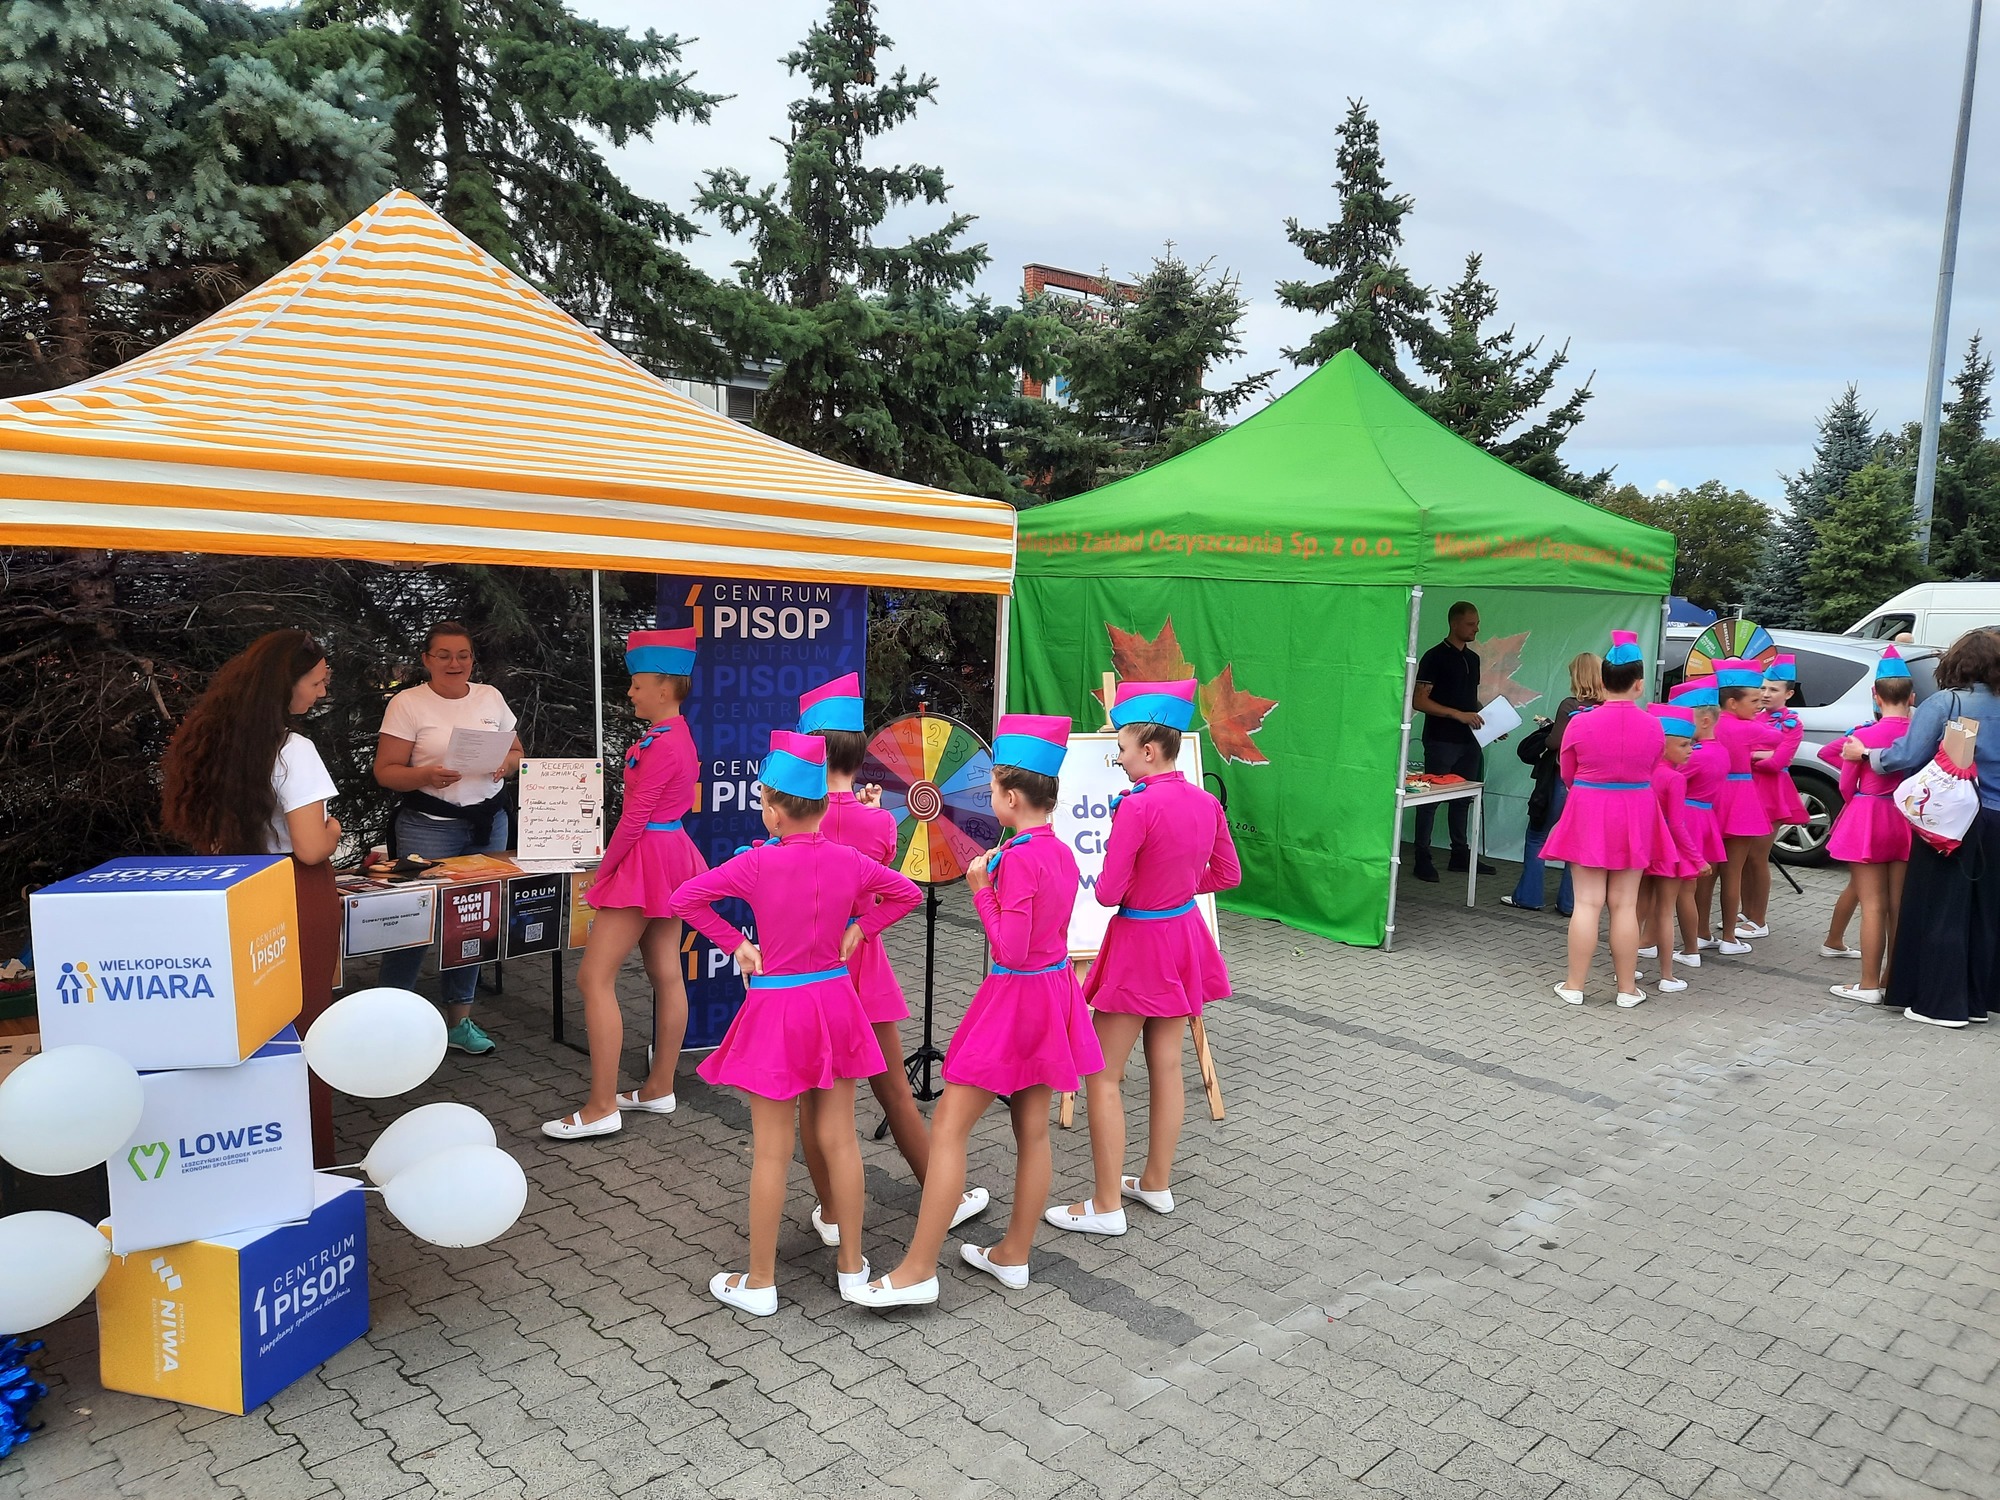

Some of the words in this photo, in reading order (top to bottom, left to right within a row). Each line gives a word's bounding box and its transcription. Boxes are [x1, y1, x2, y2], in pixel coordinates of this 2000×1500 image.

[1017, 531, 1077, 557] Miejski
[1082, 529, 1144, 553] Zakład
[1150, 529, 1283, 557] Oczyszczania
[1290, 531, 1325, 561] Sp.
[1332, 537, 1345, 556] z
[1352, 537, 1399, 557] o.o.
[714, 584, 831, 603] CENTRUM
[714, 606, 831, 640] PISOP
[713, 644, 830, 662] CENTRUM
[713, 702, 792, 718] CENTR
[926, 723, 942, 748] 2
[946, 734, 969, 763] 3
[540, 761, 585, 770] RECEPTURA
[712, 780, 764, 812] PIS
[88, 868, 218, 879] PISOP
[452, 892, 482, 906] ZACH
[514, 886, 556, 900] FORUM
[460, 911, 482, 923] NIKI
[255, 921, 286, 948] CENTRUM
[98, 957, 213, 972] WIELKOPOLSKA
[257, 935, 287, 970] PISOP
[100, 973, 216, 1002] WIARA
[179, 1121, 283, 1158] LOWES
[180, 1156, 222, 1169] LESZCZYŃSKI
[222, 1151, 252, 1161] OŚRODEK
[252, 1145, 283, 1156] WSPARCIA
[181, 1164, 212, 1174] EKONOMII
[273, 1233, 356, 1293] CENTRUM
[273, 1254, 356, 1327] PISOP
[160, 1299, 179, 1373] NIWA
